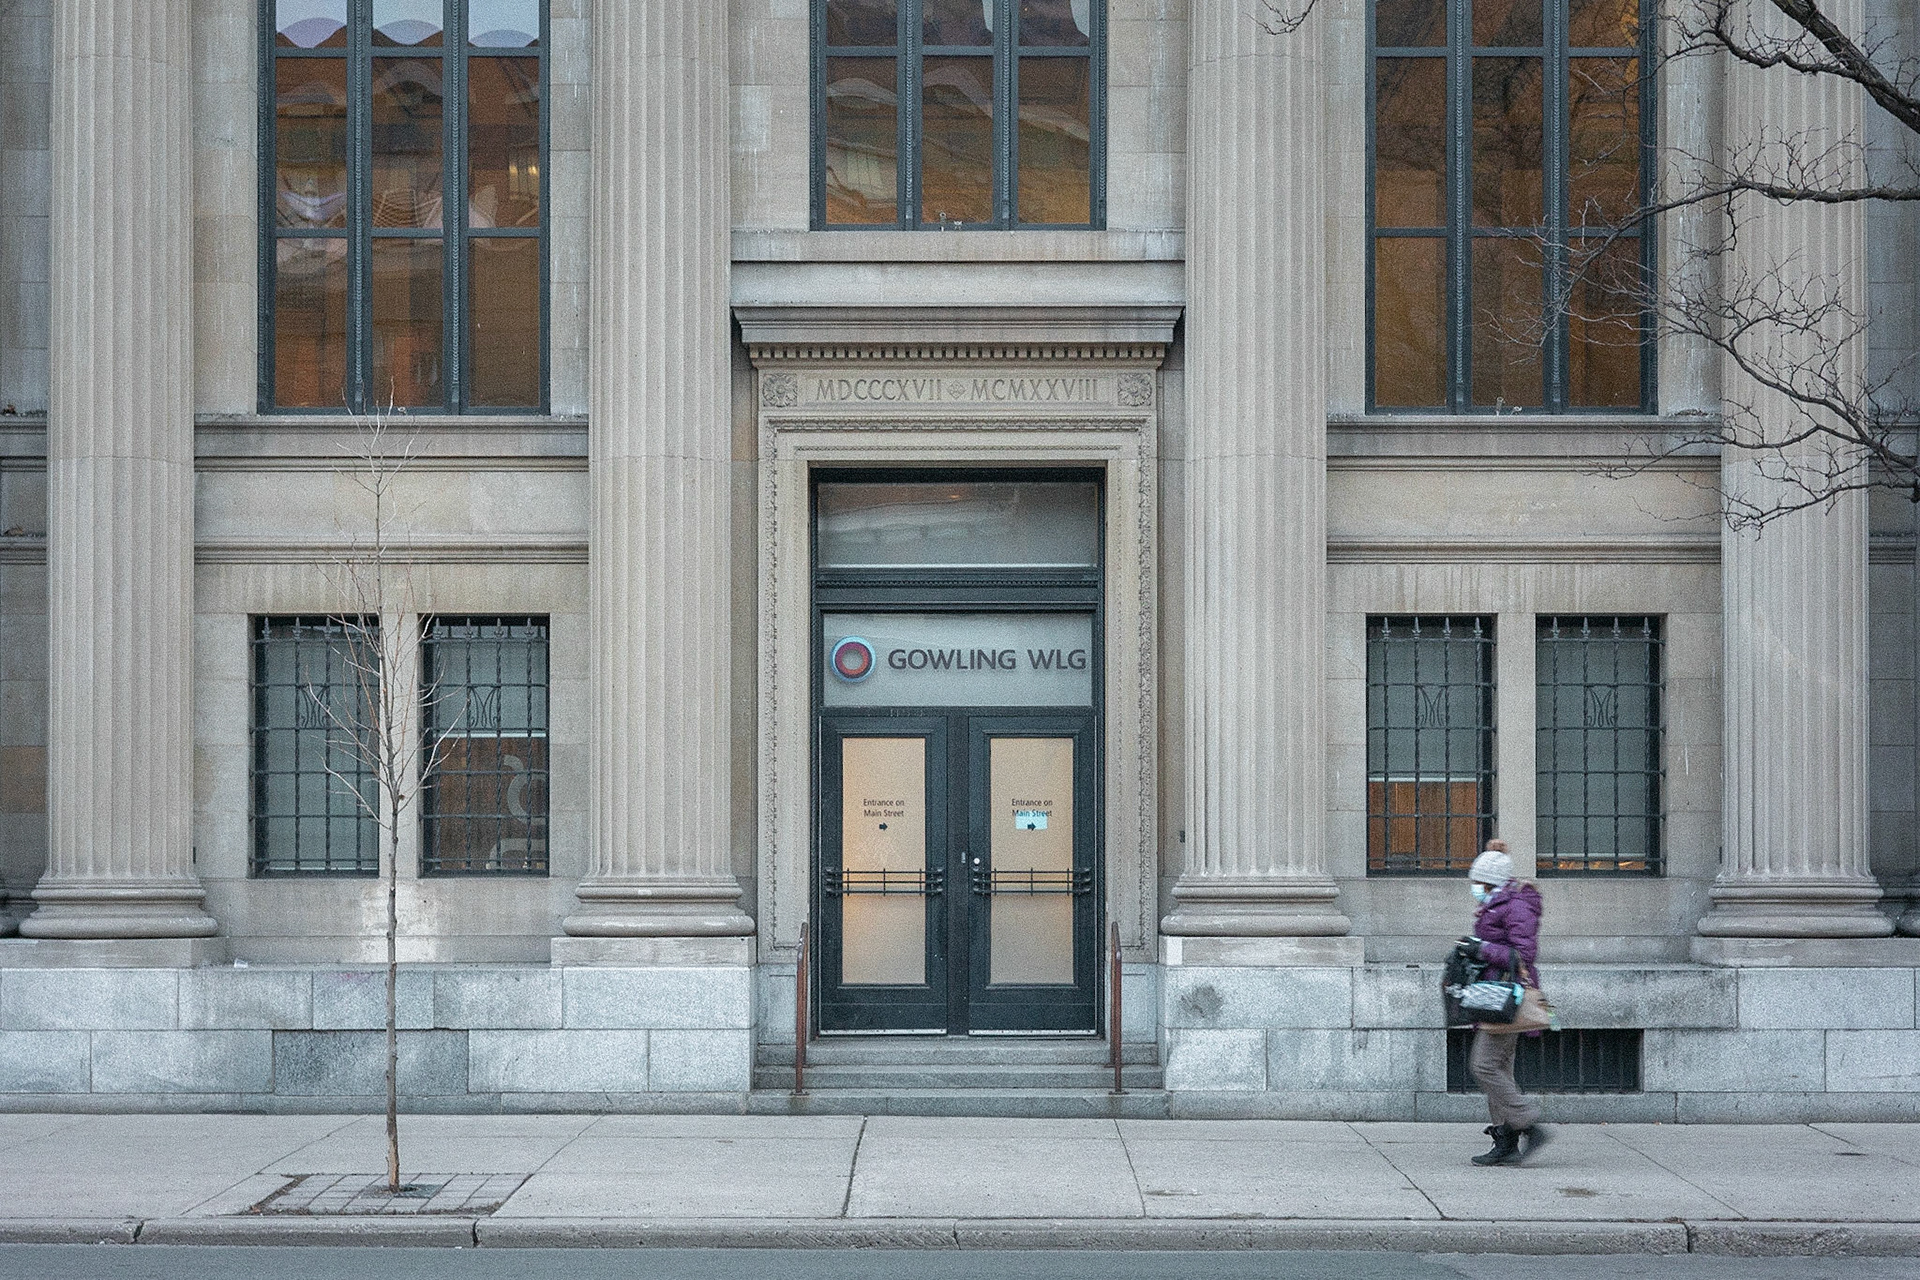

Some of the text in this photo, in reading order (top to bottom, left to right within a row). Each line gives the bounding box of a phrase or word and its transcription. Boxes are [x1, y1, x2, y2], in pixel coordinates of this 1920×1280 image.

[816, 379, 1097, 401] MDCCCXVII MCMXXVIII
[887, 648, 1087, 671] GOWLING WLG
[863, 798, 905, 807] Entrance on
[1011, 798, 1053, 807] Entrance on
[863, 808, 905, 818] Main Street
[1011, 808, 1053, 818] Main Street
